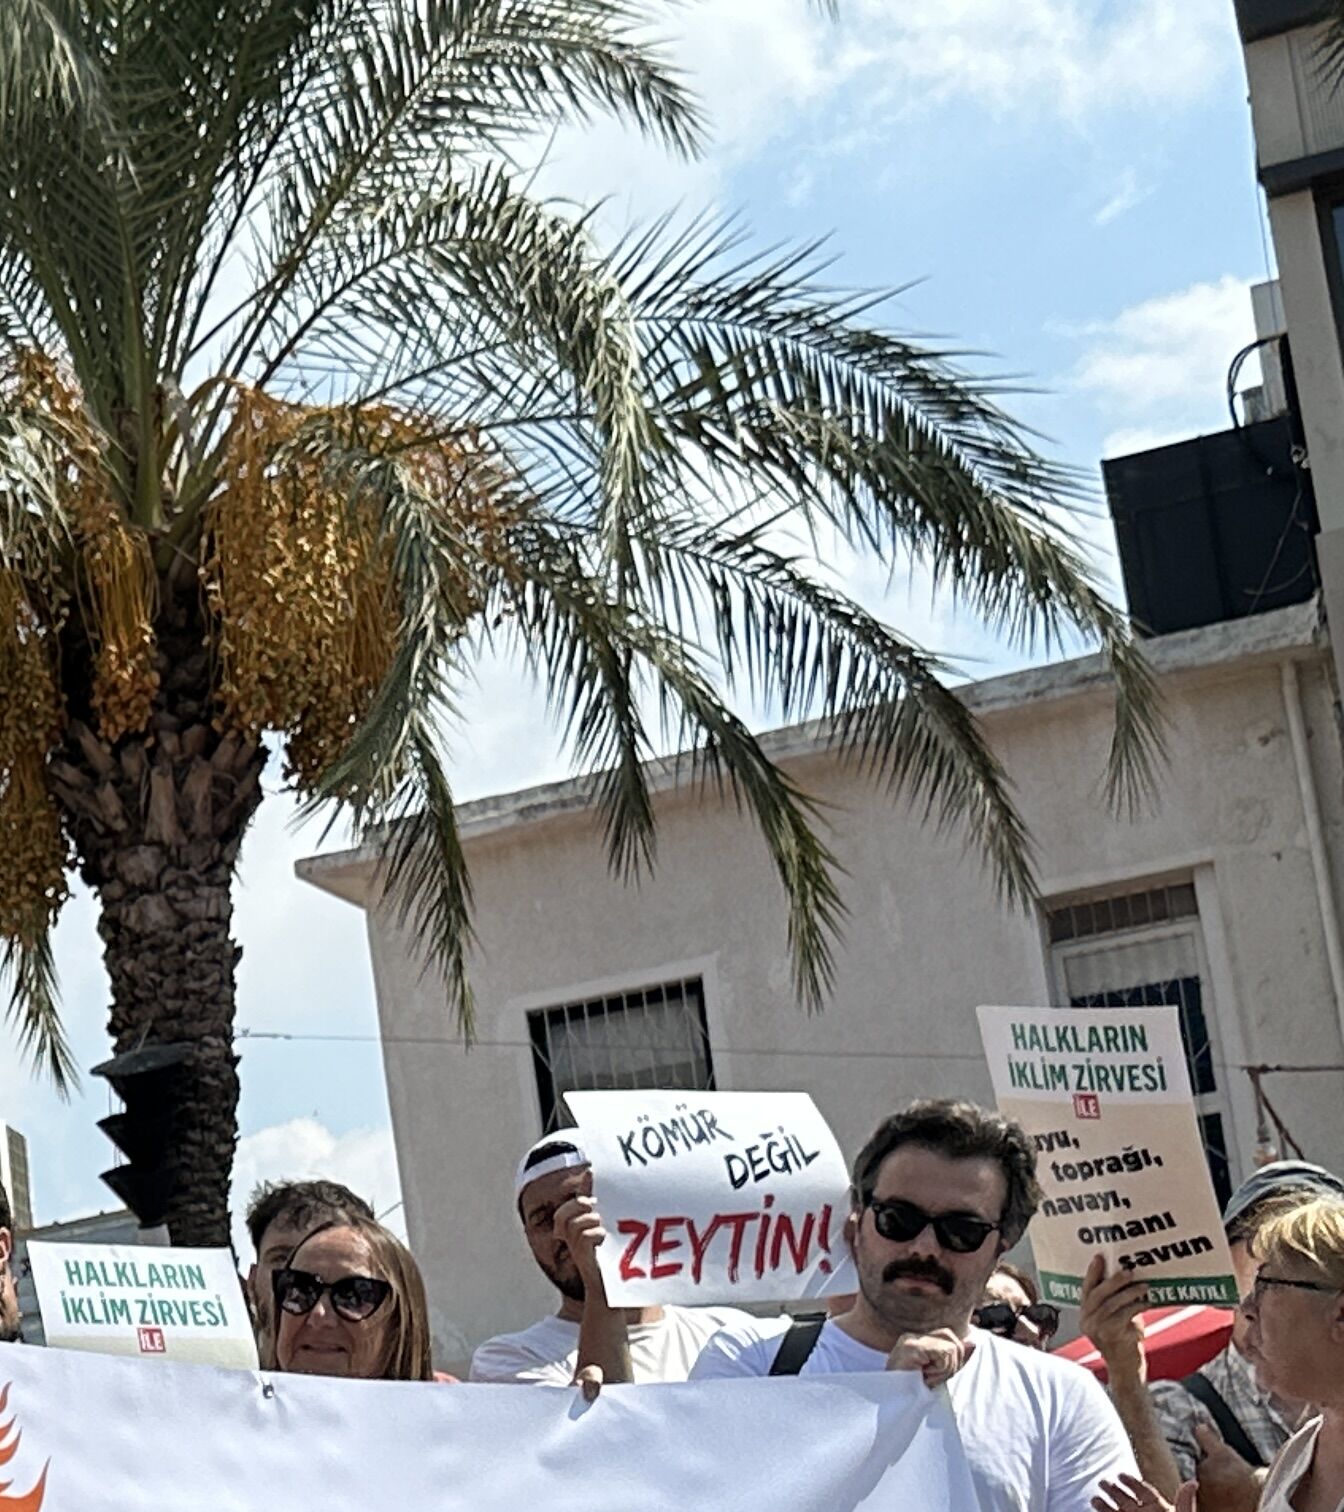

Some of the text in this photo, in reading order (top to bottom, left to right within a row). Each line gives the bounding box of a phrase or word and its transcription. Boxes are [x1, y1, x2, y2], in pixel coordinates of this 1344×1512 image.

[1010, 1022, 1149, 1053] HALKLARIN
[1007, 1053, 1168, 1092] İKLİM ZİRVESİ
[1076, 1095, 1099, 1118] İLE
[616, 1103, 735, 1167] KÖMÜR
[723, 1126, 821, 1190] DEĞİL
[1050, 1145, 1164, 1182] toprağı,
[616, 1193, 834, 1285] ZEYTİN!
[1077, 1211, 1177, 1245] ormanı
[63, 1259, 207, 1290] HALKLARIN
[1178, 1283, 1227, 1301] KATIL!
[60, 1291, 229, 1328] İKLİM ZİRVESİ
[139, 1329, 165, 1351] İLE
